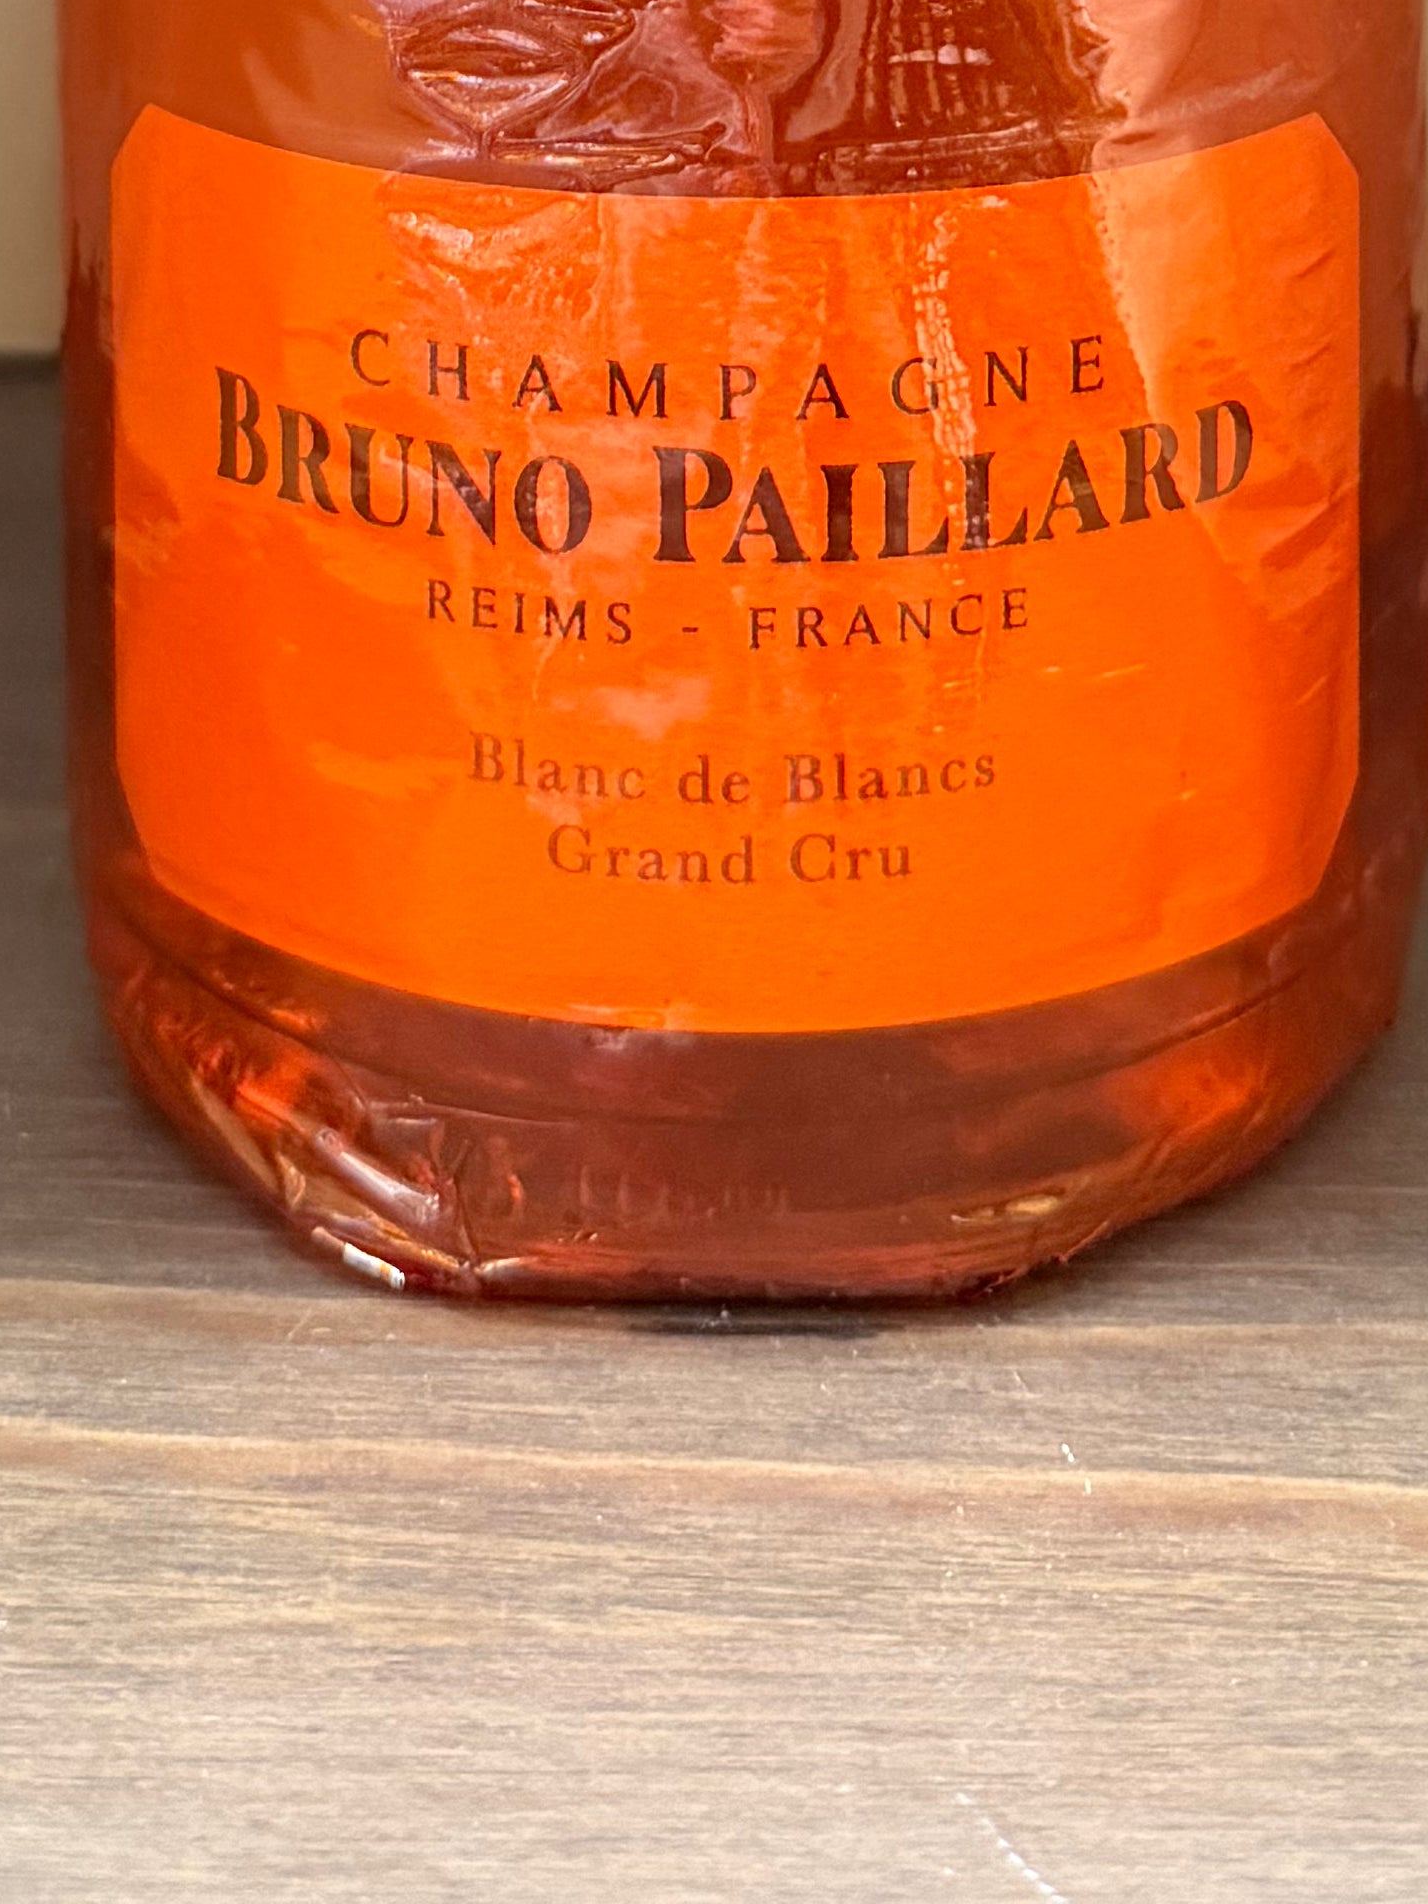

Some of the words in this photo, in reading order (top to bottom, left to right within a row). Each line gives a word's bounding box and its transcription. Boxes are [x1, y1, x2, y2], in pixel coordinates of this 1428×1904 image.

[349, 327, 1106, 421] CHAMPAGNE
[214, 364, 594, 556] BRUNO
[653, 398, 1255, 565] PAILLARD
[426, 578, 634, 647] REIMS
[748, 586, 1032, 651] FRANCE
[467, 729, 648, 801] Blanc
[676, 750, 752, 805] de
[785, 748, 999, 805] Blancs
[547, 823, 757, 887] Grand
[788, 831, 915, 884] Cru
